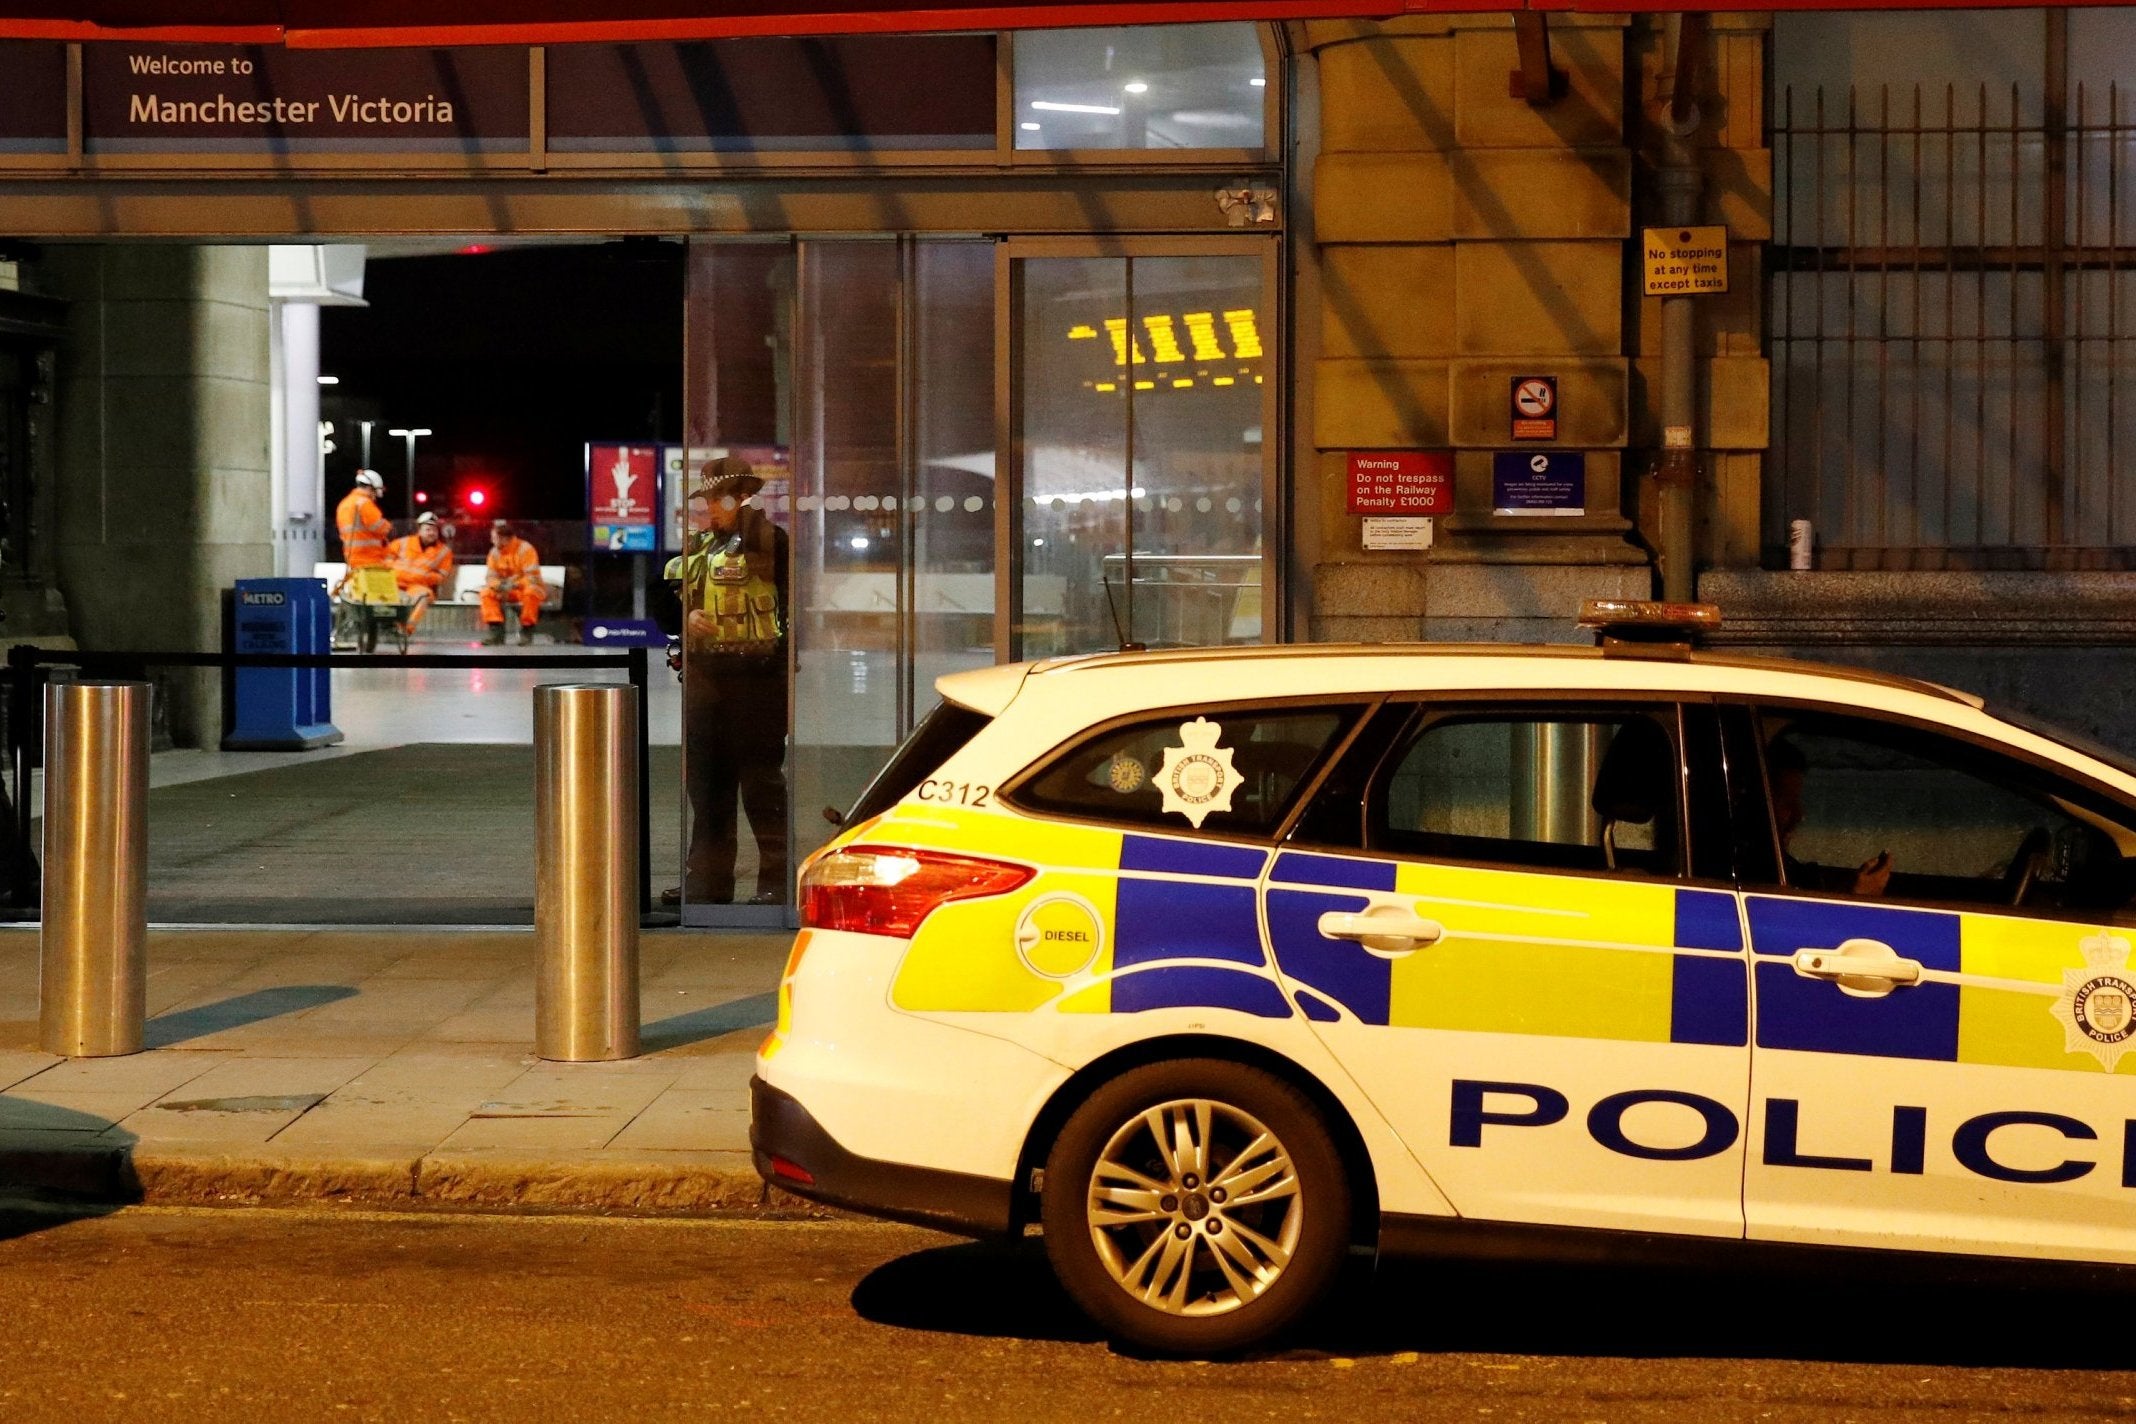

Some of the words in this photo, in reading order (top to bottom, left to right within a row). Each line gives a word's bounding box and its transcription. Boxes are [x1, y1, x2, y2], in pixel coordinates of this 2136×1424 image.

[129, 55, 224, 75] Welcome
[231, 58, 253, 75] to
[129, 93, 319, 123] Manchester
[328, 94, 453, 123] Victoria
[1649, 249, 1666, 259] No
[1670, 248, 1722, 259] stopping
[1654, 265, 1665, 275] at
[1669, 265, 1689, 275] any
[1693, 263, 1717, 274] time
[1650, 279, 1689, 289] except
[1695, 277, 1723, 288] taxis
[1357, 459, 1399, 470] Warning
[1356, 473, 1371, 483] Do
[1376, 474, 1393, 483] not
[1398, 474, 1445, 484] trespass
[1356, 487, 1370, 495] on
[1375, 485, 1391, 495] the
[1396, 485, 1436, 495] Railway
[1356, 497, 1396, 507] Penalty
[1400, 496, 1434, 506] £1000
[243, 592, 283, 604] METRO
[917, 779, 990, 808] C312
[1045, 930, 1090, 943] DIESEL
[2075, 981, 2096, 1022] BRITISH
[2088, 1030, 2129, 1043] POLICE
[1449, 1079, 2136, 1188] POLIC
